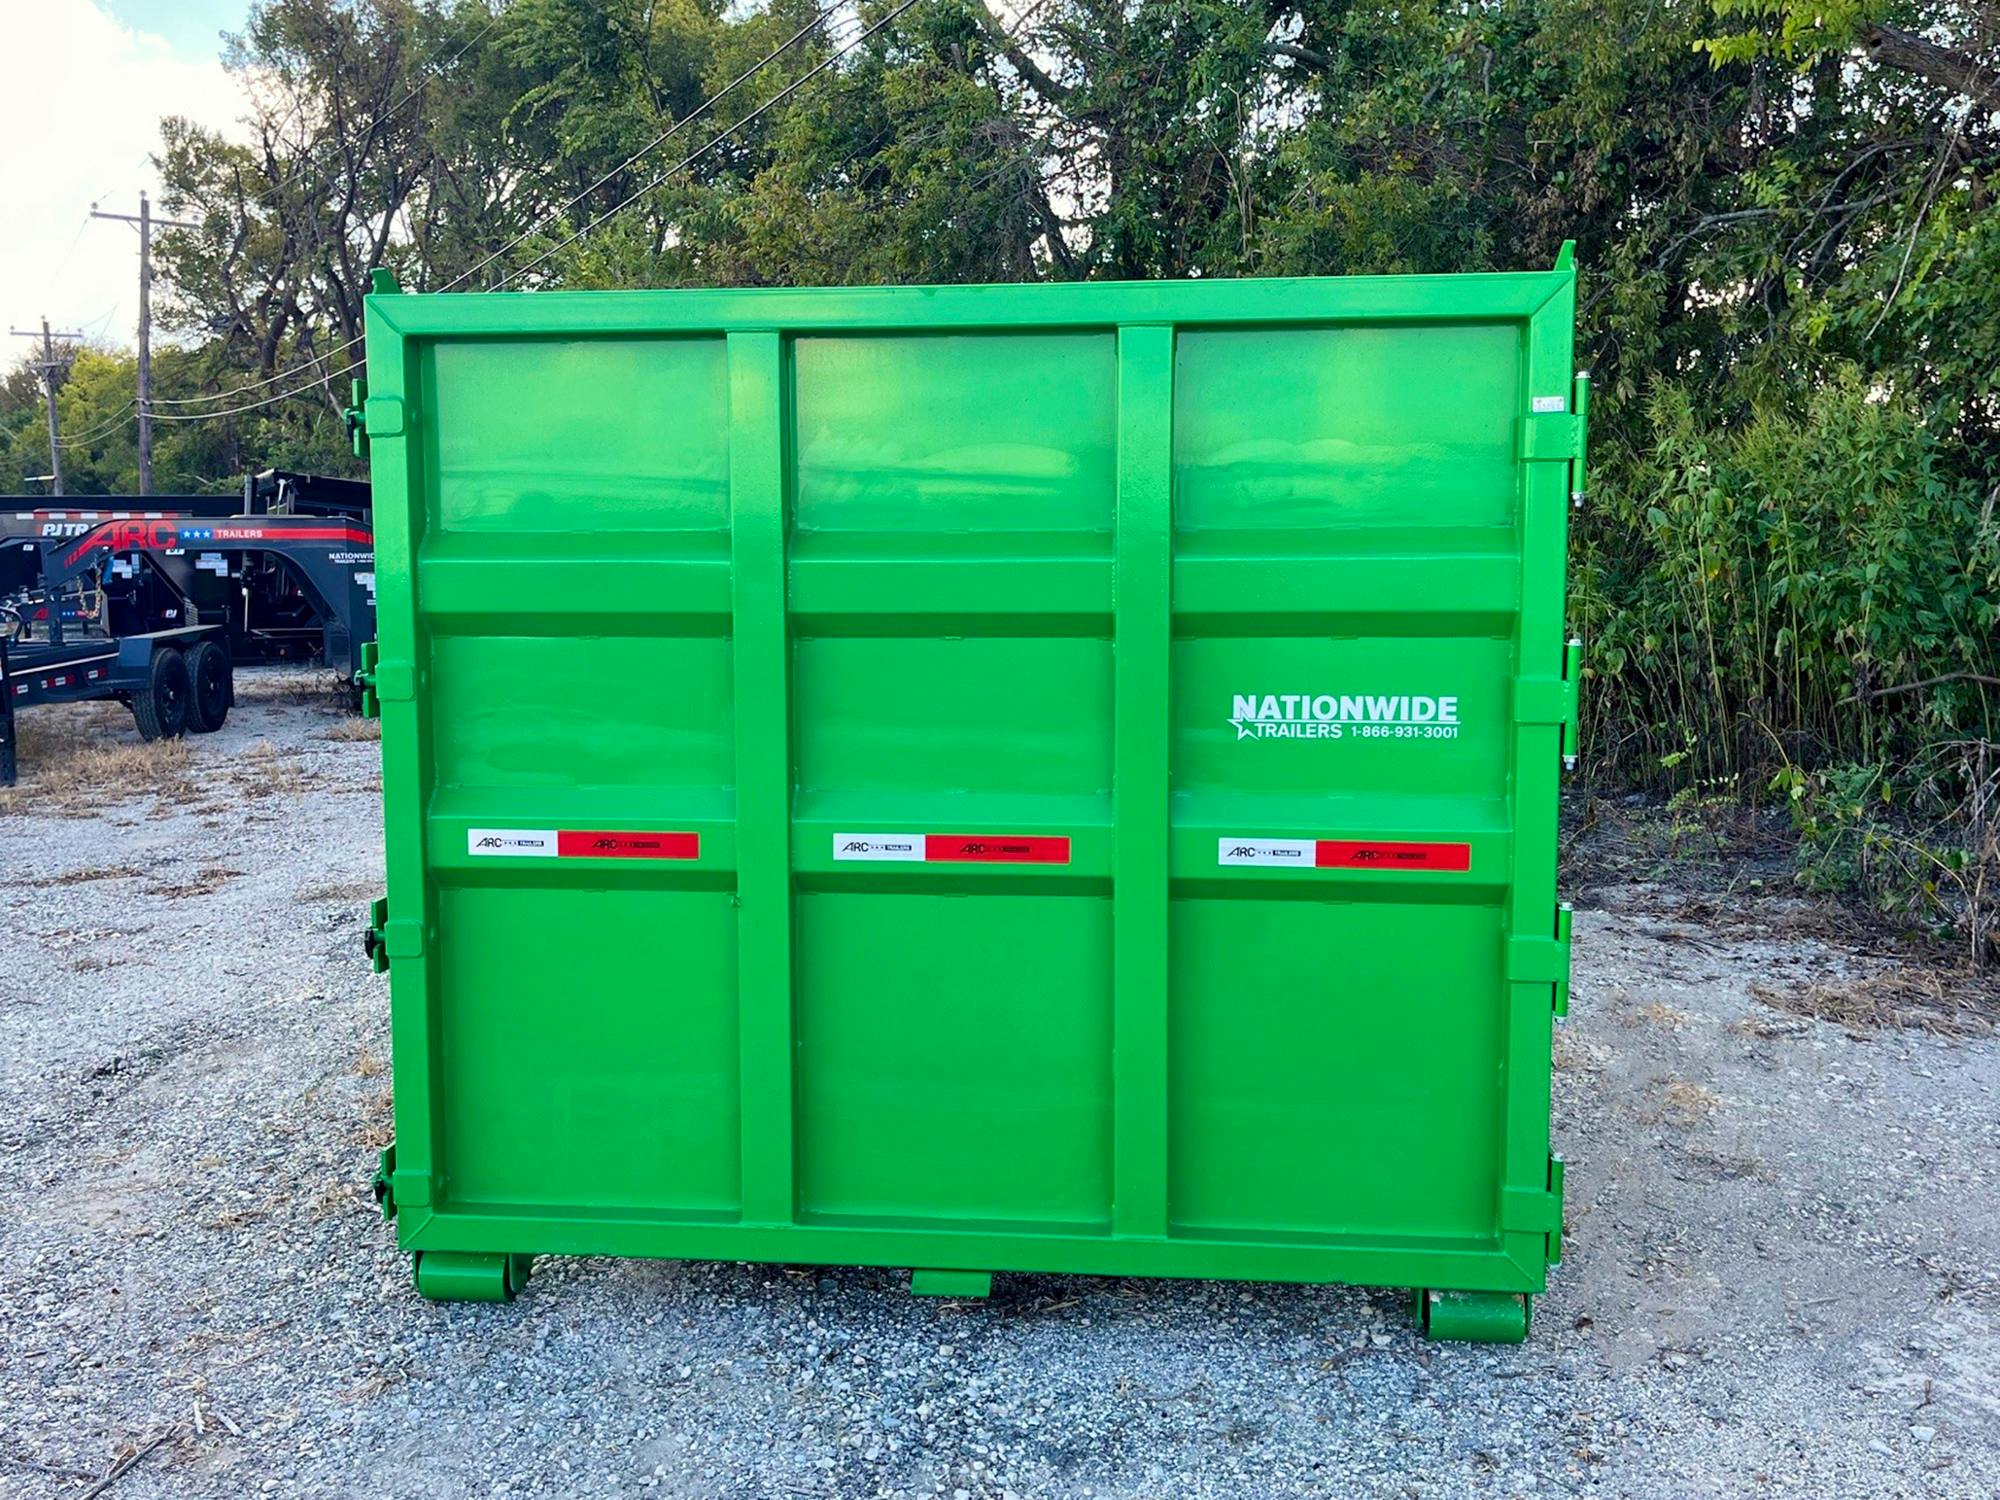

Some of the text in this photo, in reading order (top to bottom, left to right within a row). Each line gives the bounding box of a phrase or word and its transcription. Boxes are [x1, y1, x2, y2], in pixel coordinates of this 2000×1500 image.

[64, 520, 177, 568] ARC
[217, 529, 263, 539] TRAILERS
[1233, 695, 1457, 721] NATIONWIDE
[1254, 723, 1458, 738] TRAILERS 1-866-931-3001
[476, 838, 502, 848] ARC
[842, 842, 869, 852] ARC
[1227, 847, 1256, 857] ARC
